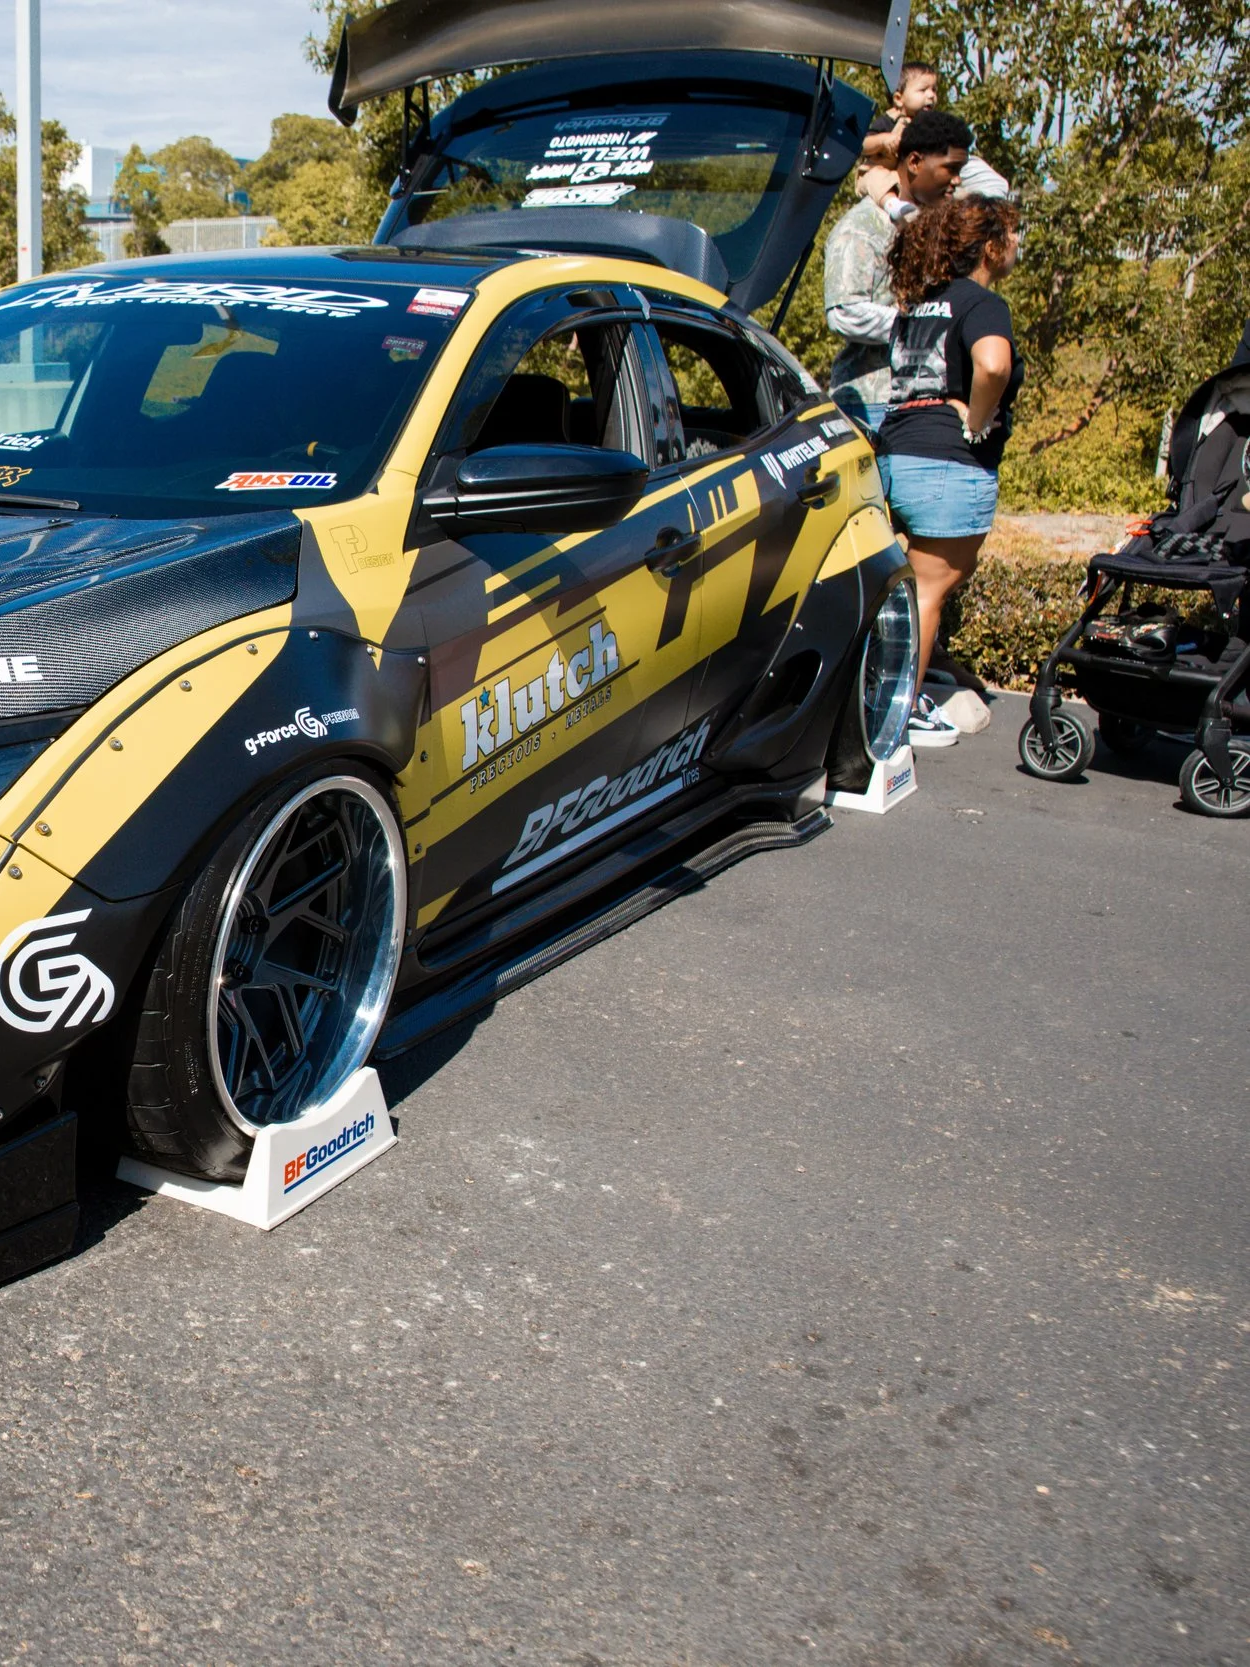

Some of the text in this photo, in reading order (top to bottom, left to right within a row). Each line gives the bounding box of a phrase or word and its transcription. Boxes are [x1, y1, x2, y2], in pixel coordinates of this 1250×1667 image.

[554, 116, 669, 132] BFGoodrich
[549, 132, 625, 148] MISHIMOTO
[581, 146, 651, 161] WELL
[141, 297, 245, 307] STREET
[266, 304, 357, 318] SHOW
[906, 301, 953, 318] ONDA
[776, 435, 830, 471] WHITELINE
[228, 474, 334, 488] AMSOIL
[358, 552, 395, 570] DESIGN
[460, 620, 620, 772] klutch
[321, 708, 360, 726] PHENOM
[244, 723, 299, 756] g-Force
[470, 685, 612, 794] PRECIOUS METALS
[681, 766, 700, 789] Tires
[502, 717, 711, 870] BFGoodrich
[284, 1112, 375, 1186] BFGoodrich
